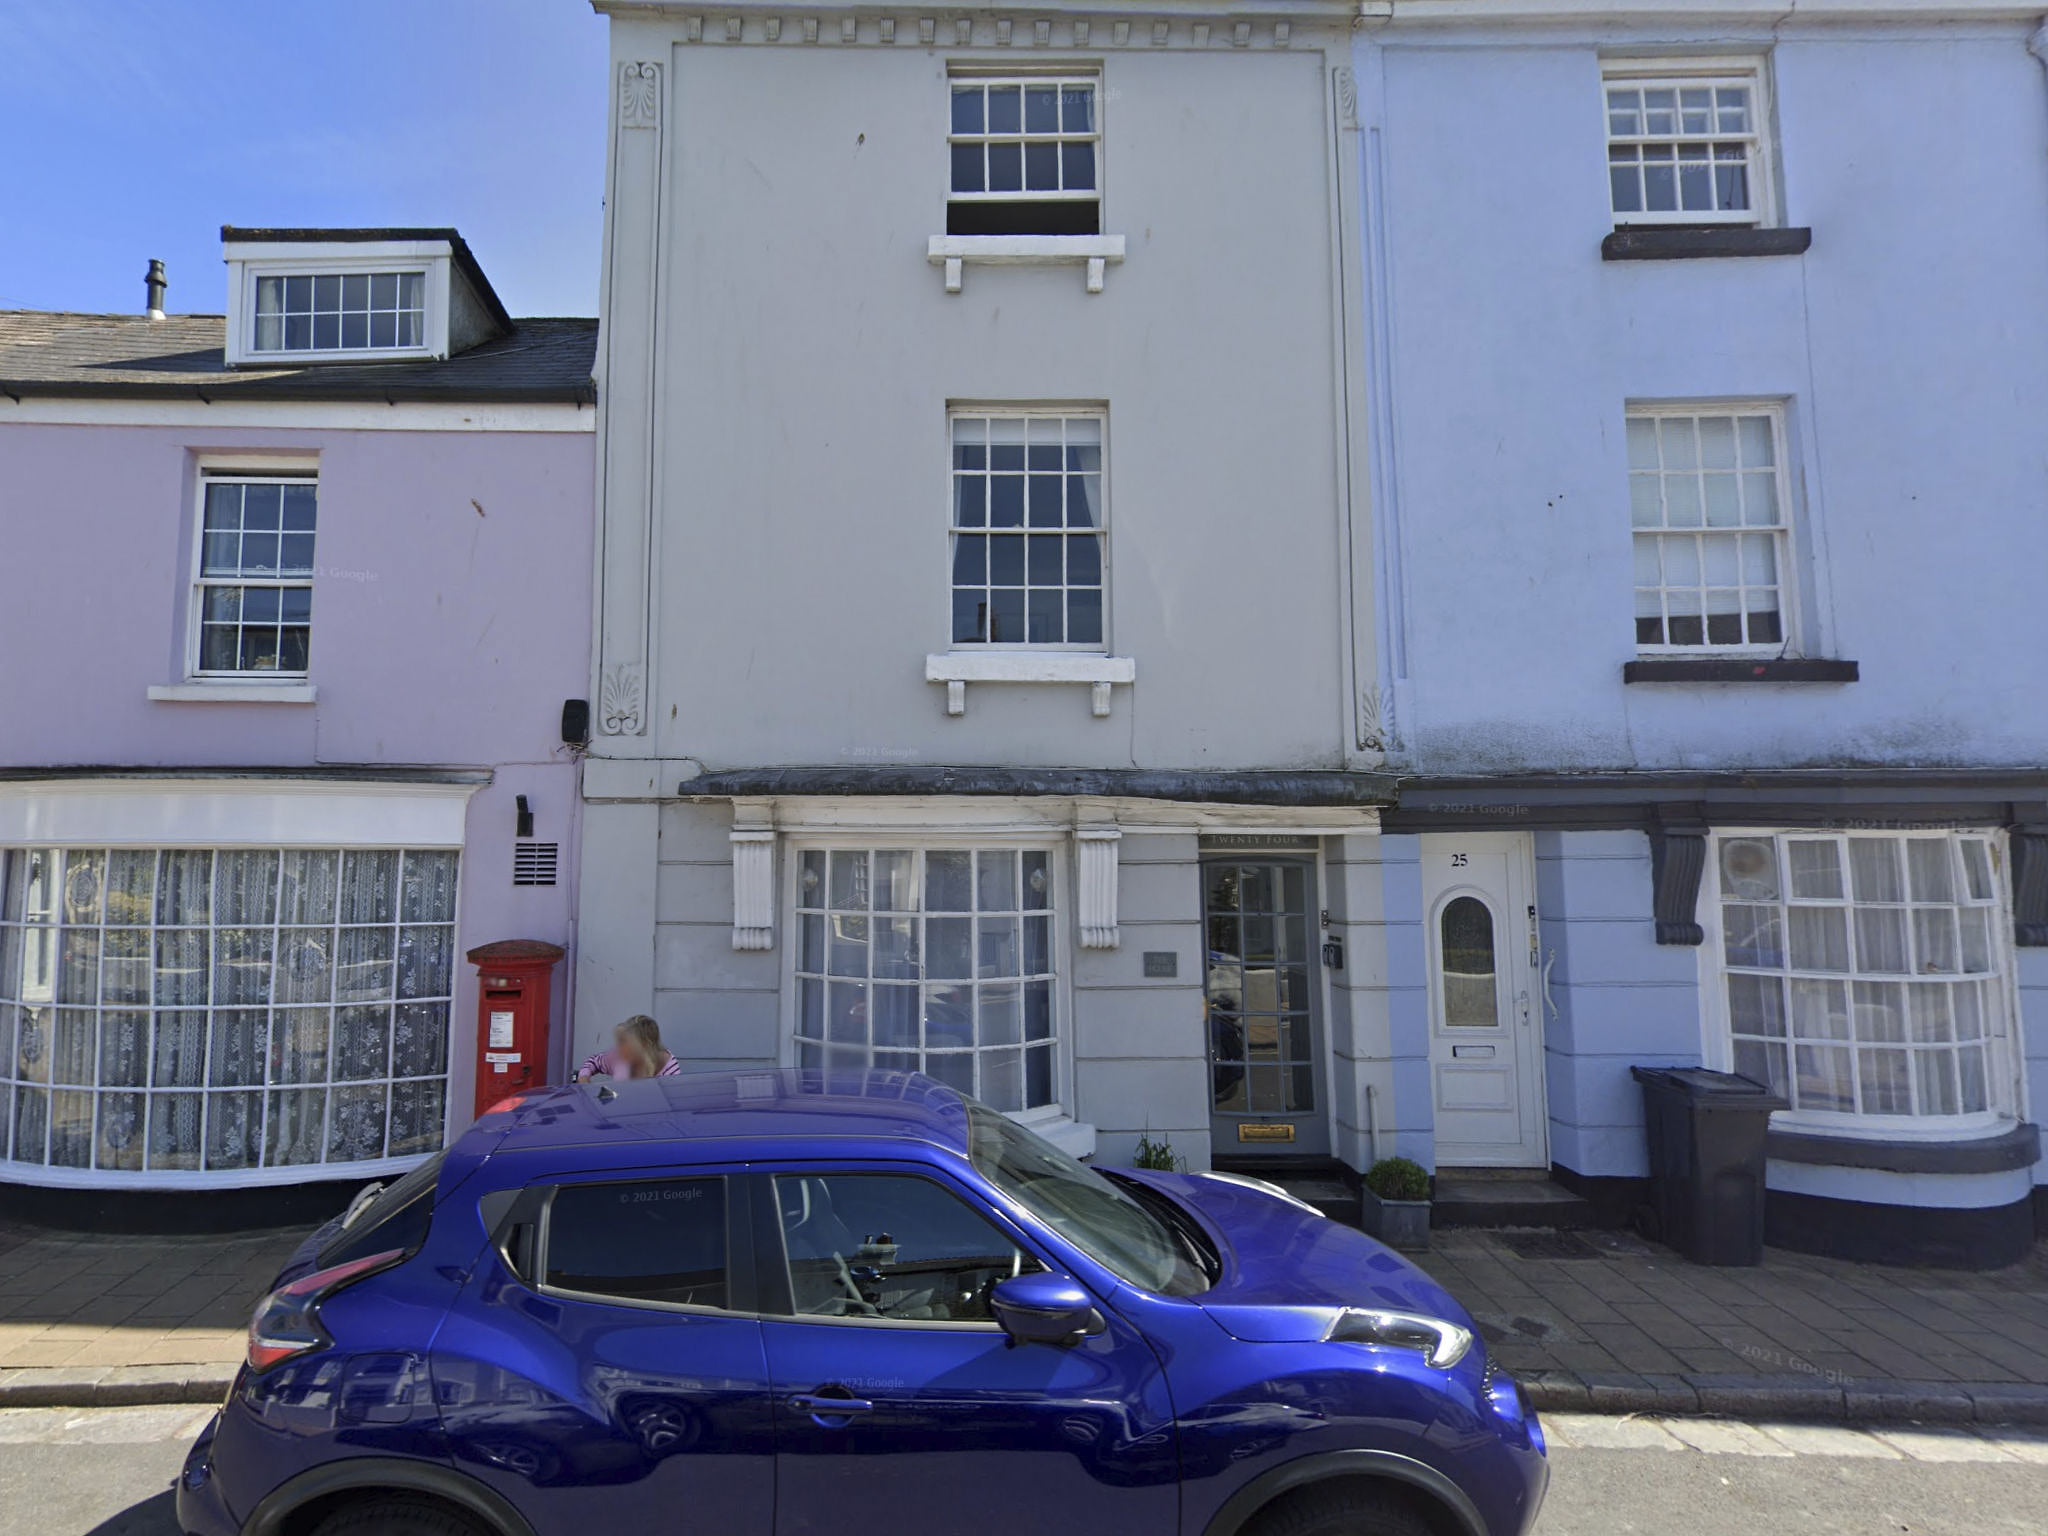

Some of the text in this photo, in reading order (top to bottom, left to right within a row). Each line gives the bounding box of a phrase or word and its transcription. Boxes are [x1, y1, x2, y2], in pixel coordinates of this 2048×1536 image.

[1212, 835, 1299, 844] TWENTY FOUR
[1451, 854, 1468, 866] 25
